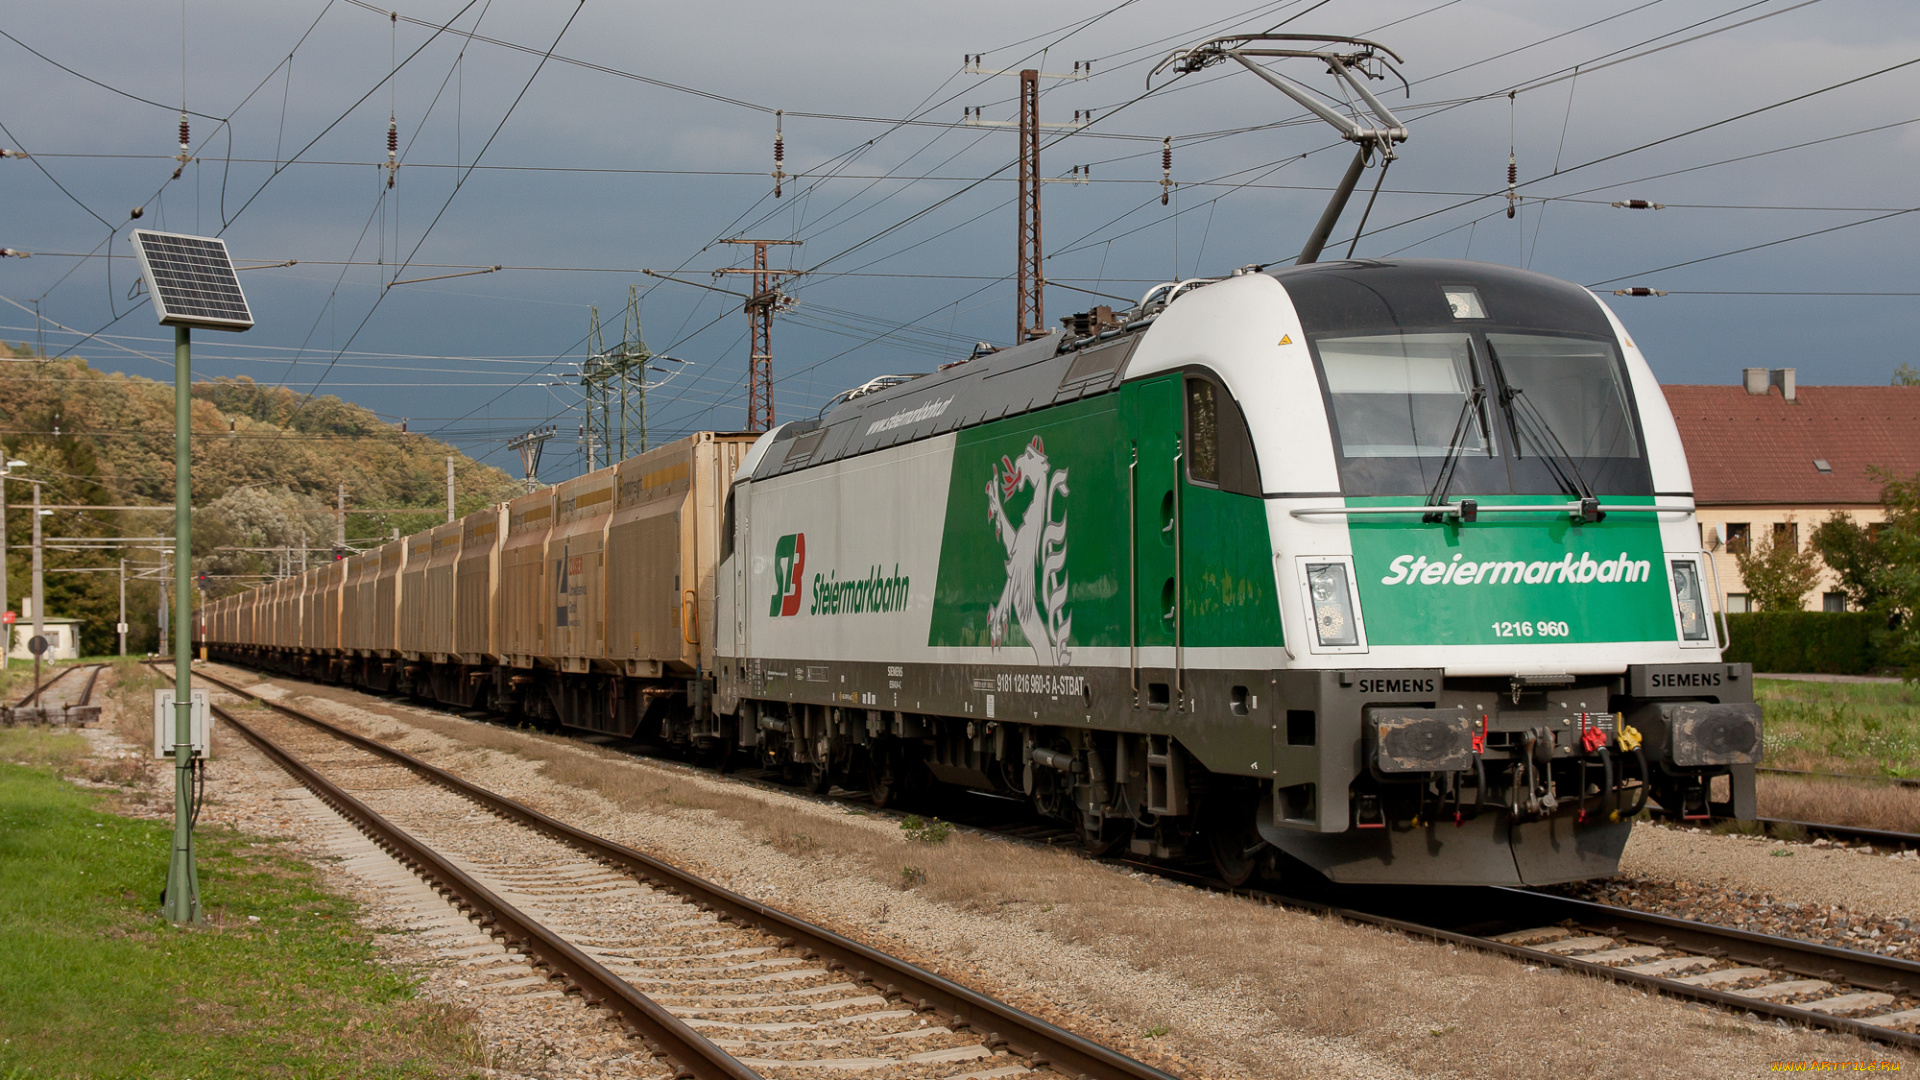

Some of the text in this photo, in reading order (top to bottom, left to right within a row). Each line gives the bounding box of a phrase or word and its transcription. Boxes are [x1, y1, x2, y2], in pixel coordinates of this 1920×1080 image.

[1381, 551, 1650, 585] Steiermarkbahn
[810, 562, 909, 616] Steiermarkbahn
[1492, 621, 1569, 637] 1216 960
[996, 673, 1012, 693] 9181
[1014, 674, 1030, 694] 1216
[1031, 674, 1051, 695] 960-5
[1051, 675, 1085, 697] A-STBAT
[1359, 679, 1434, 693] SIEMENS
[1652, 673, 1721, 688] SIEMENS
